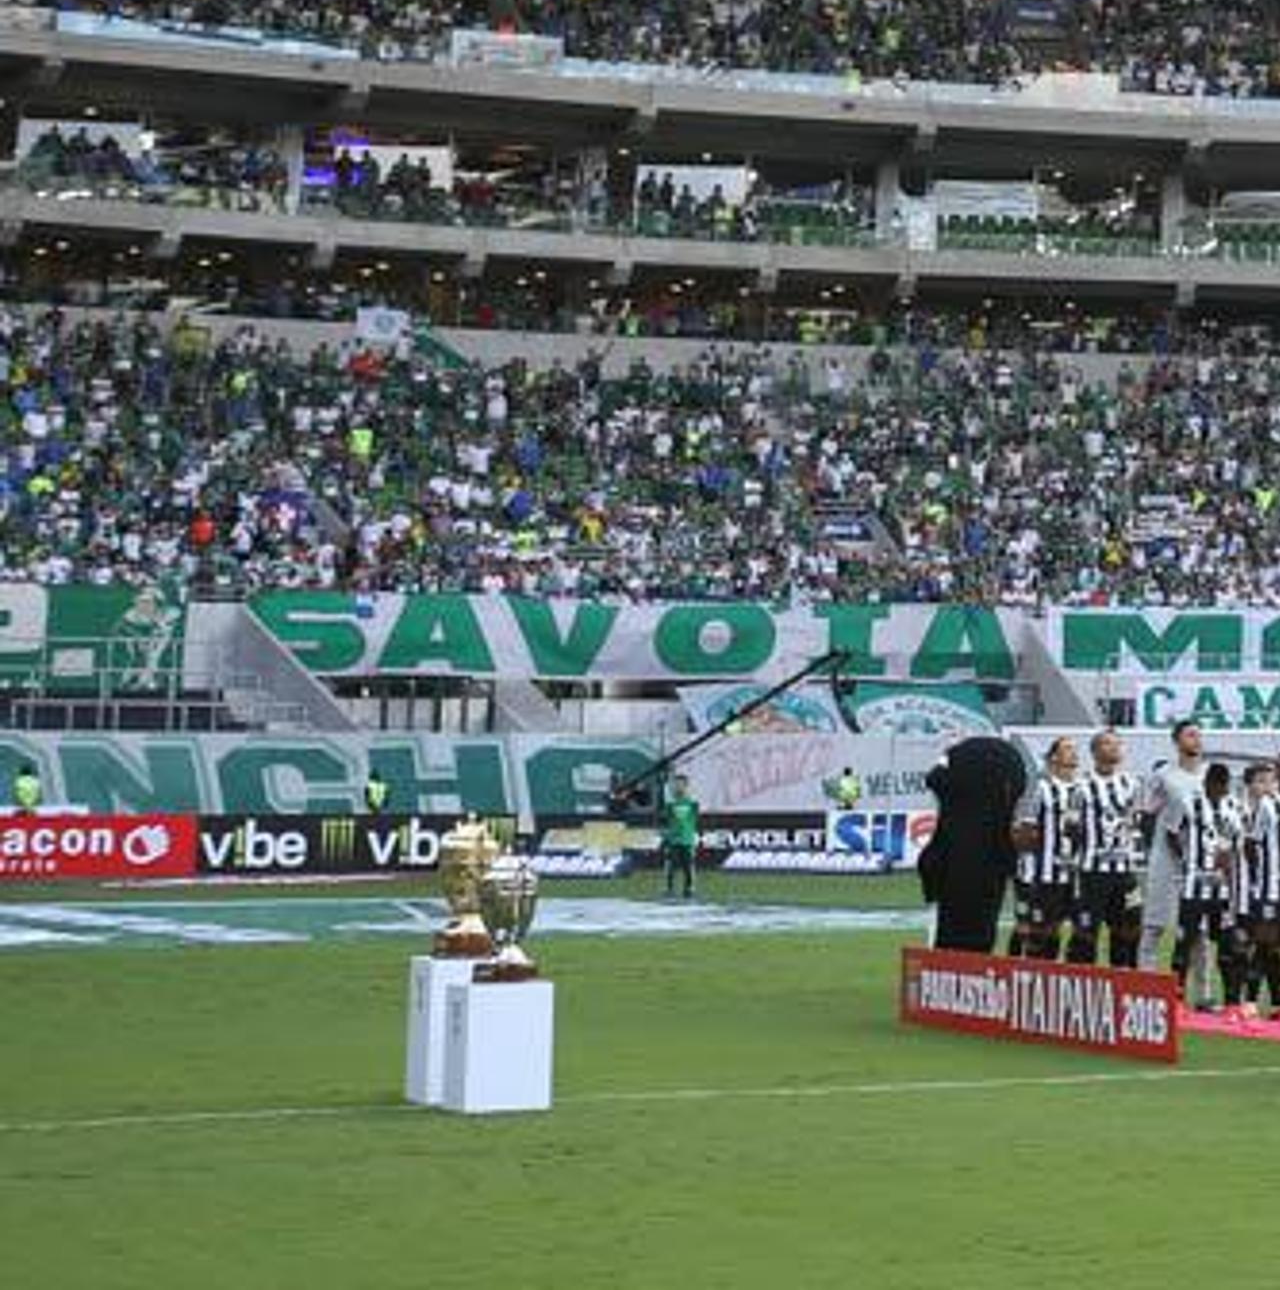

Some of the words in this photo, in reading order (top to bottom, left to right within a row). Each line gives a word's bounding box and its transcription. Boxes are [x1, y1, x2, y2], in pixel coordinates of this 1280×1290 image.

[248, 591, 1018, 678] SAVOIA
[1011, 970, 1118, 1045] ITAIPAVA
[1121, 993, 1168, 1045] 2015
